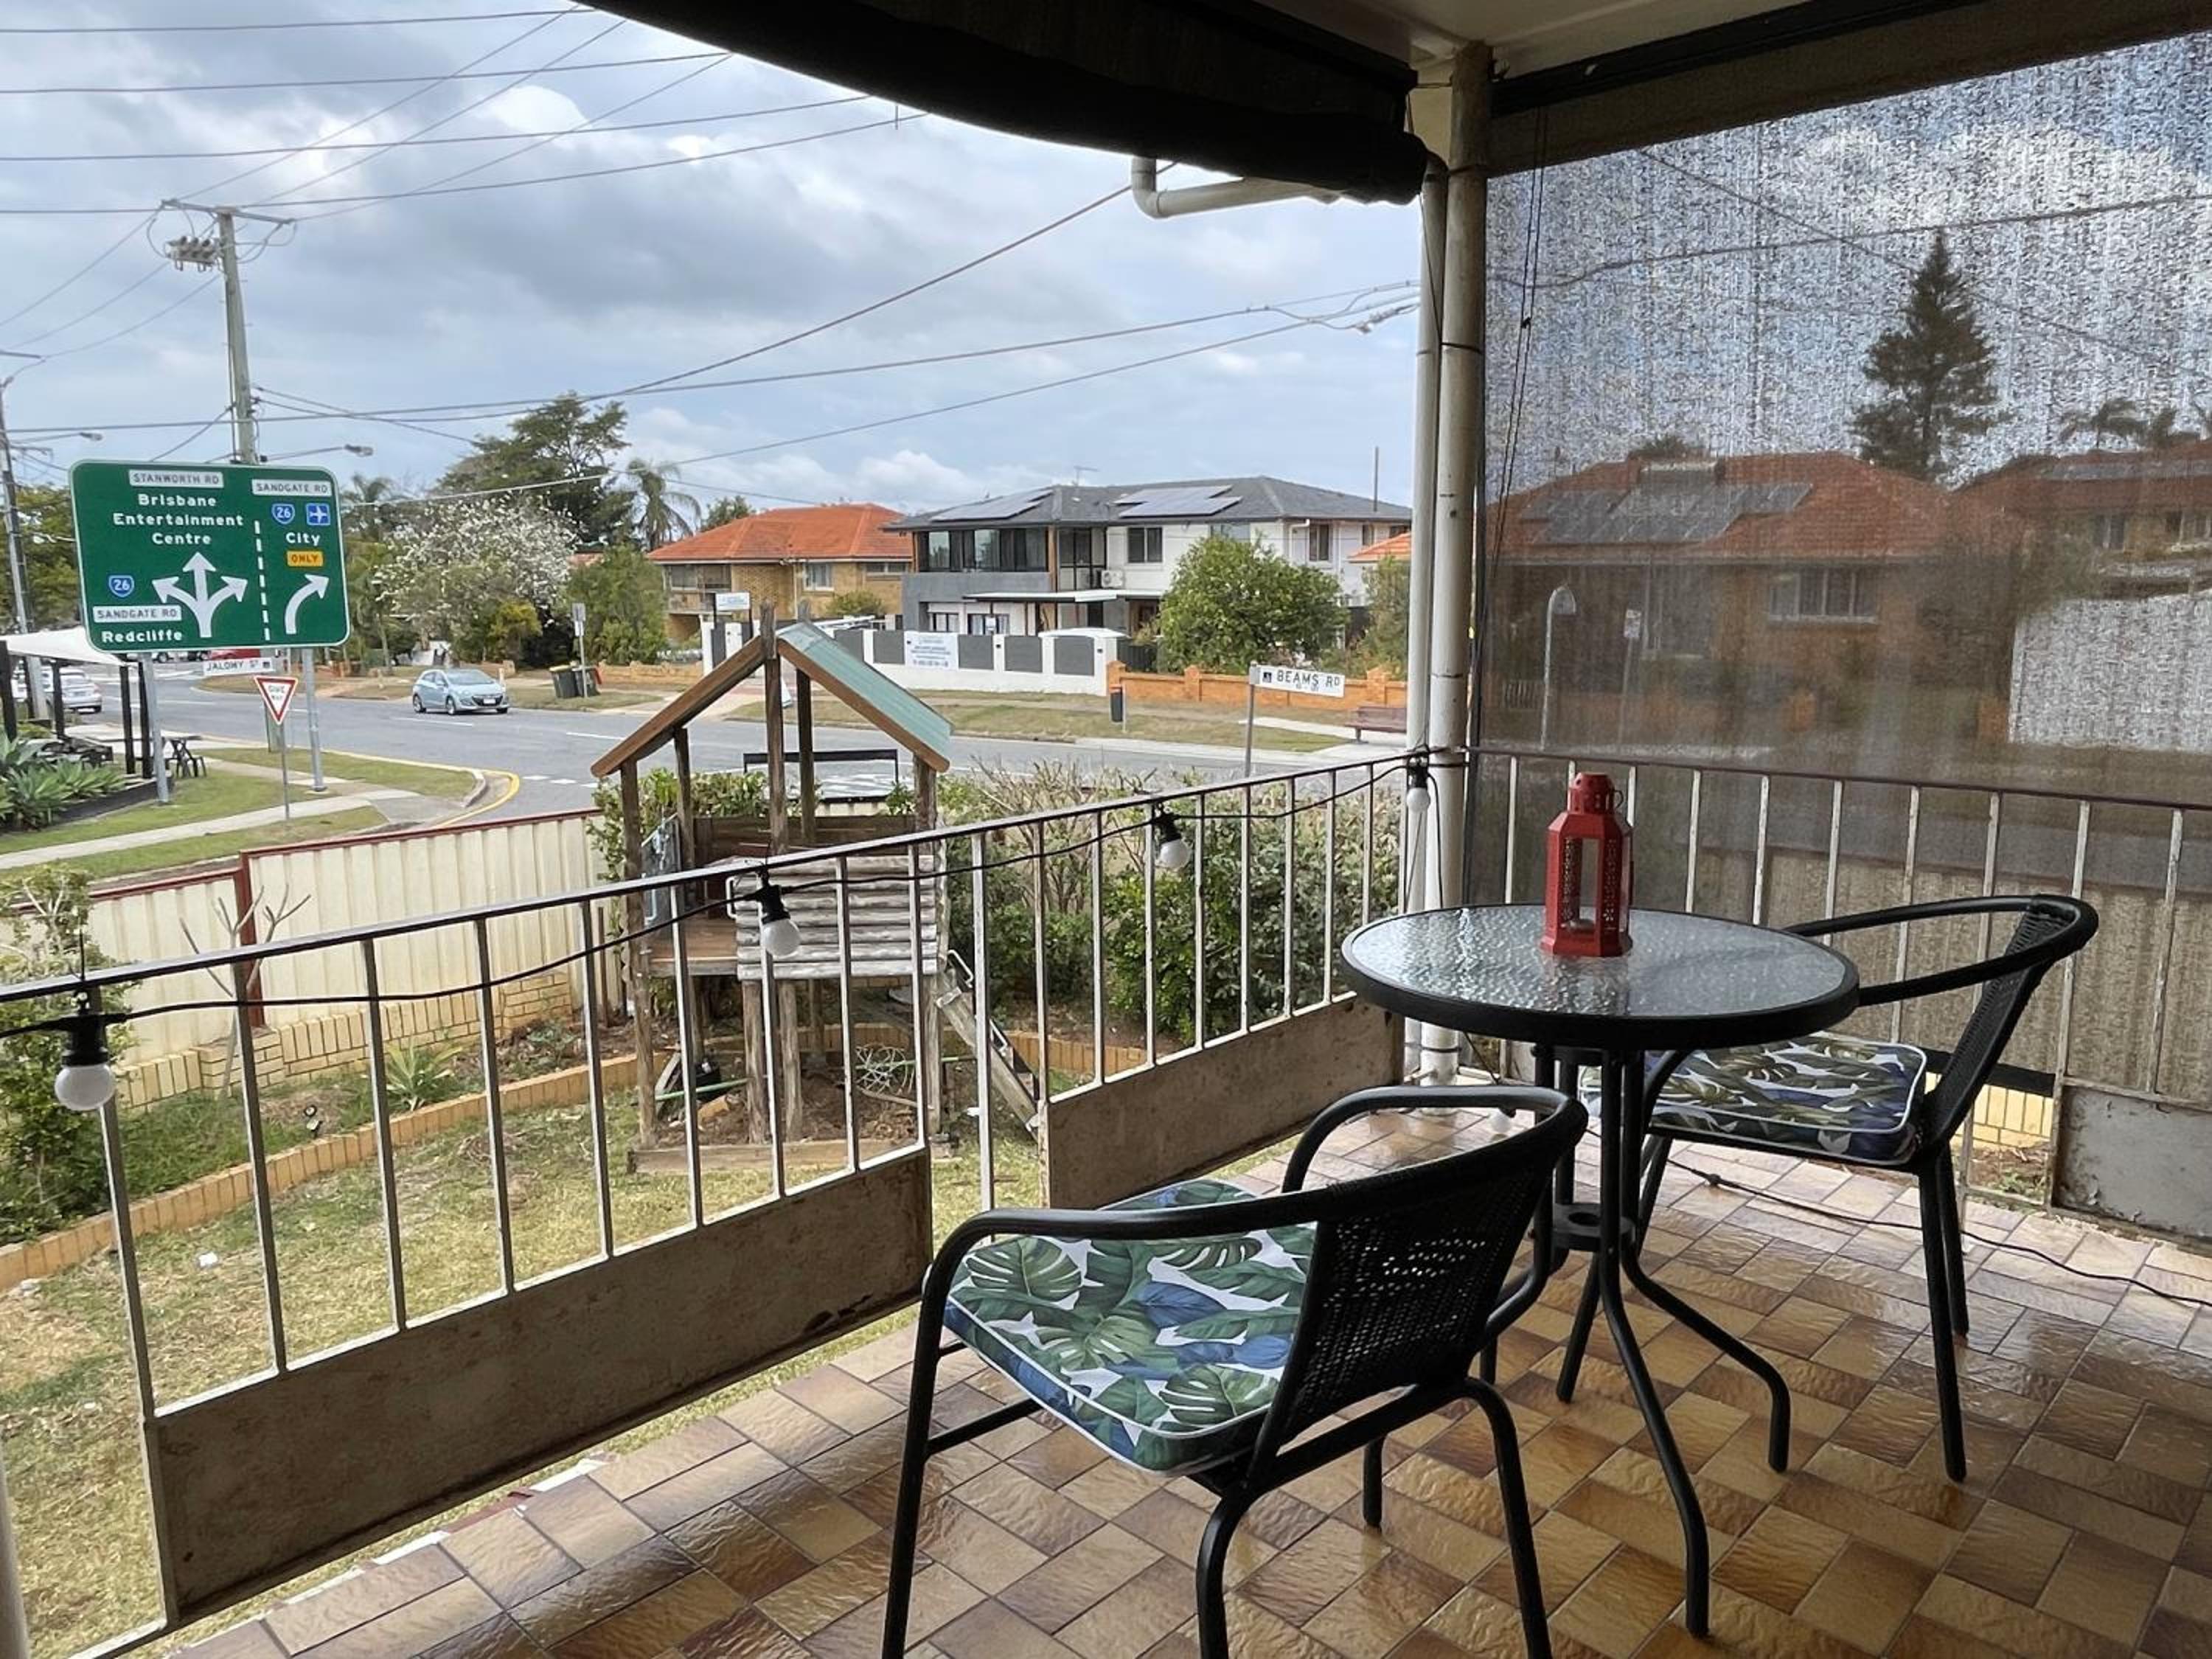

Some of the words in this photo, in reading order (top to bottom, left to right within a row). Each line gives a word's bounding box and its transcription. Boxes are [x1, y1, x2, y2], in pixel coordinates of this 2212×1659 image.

[133, 473, 200, 483] STANWORTH
[204, 475, 219, 484] RD
[256, 483, 310, 493] SANDGATE
[314, 484, 329, 493] RD
[138, 493, 216, 507] Brisbane
[276, 507, 291, 518] 26
[113, 512, 243, 526] Entertainment
[152, 532, 212, 545] Centre
[285, 532, 321, 546] City
[291, 554, 319, 563] ONLY
[114, 579, 131, 591] 26
[97, 610, 158, 619] SANDGATE
[162, 608, 177, 617] RD
[102, 629, 182, 643] Redcliffe
[1276, 669, 1319, 686] BEAMS
[1326, 675, 1340, 687] RD
